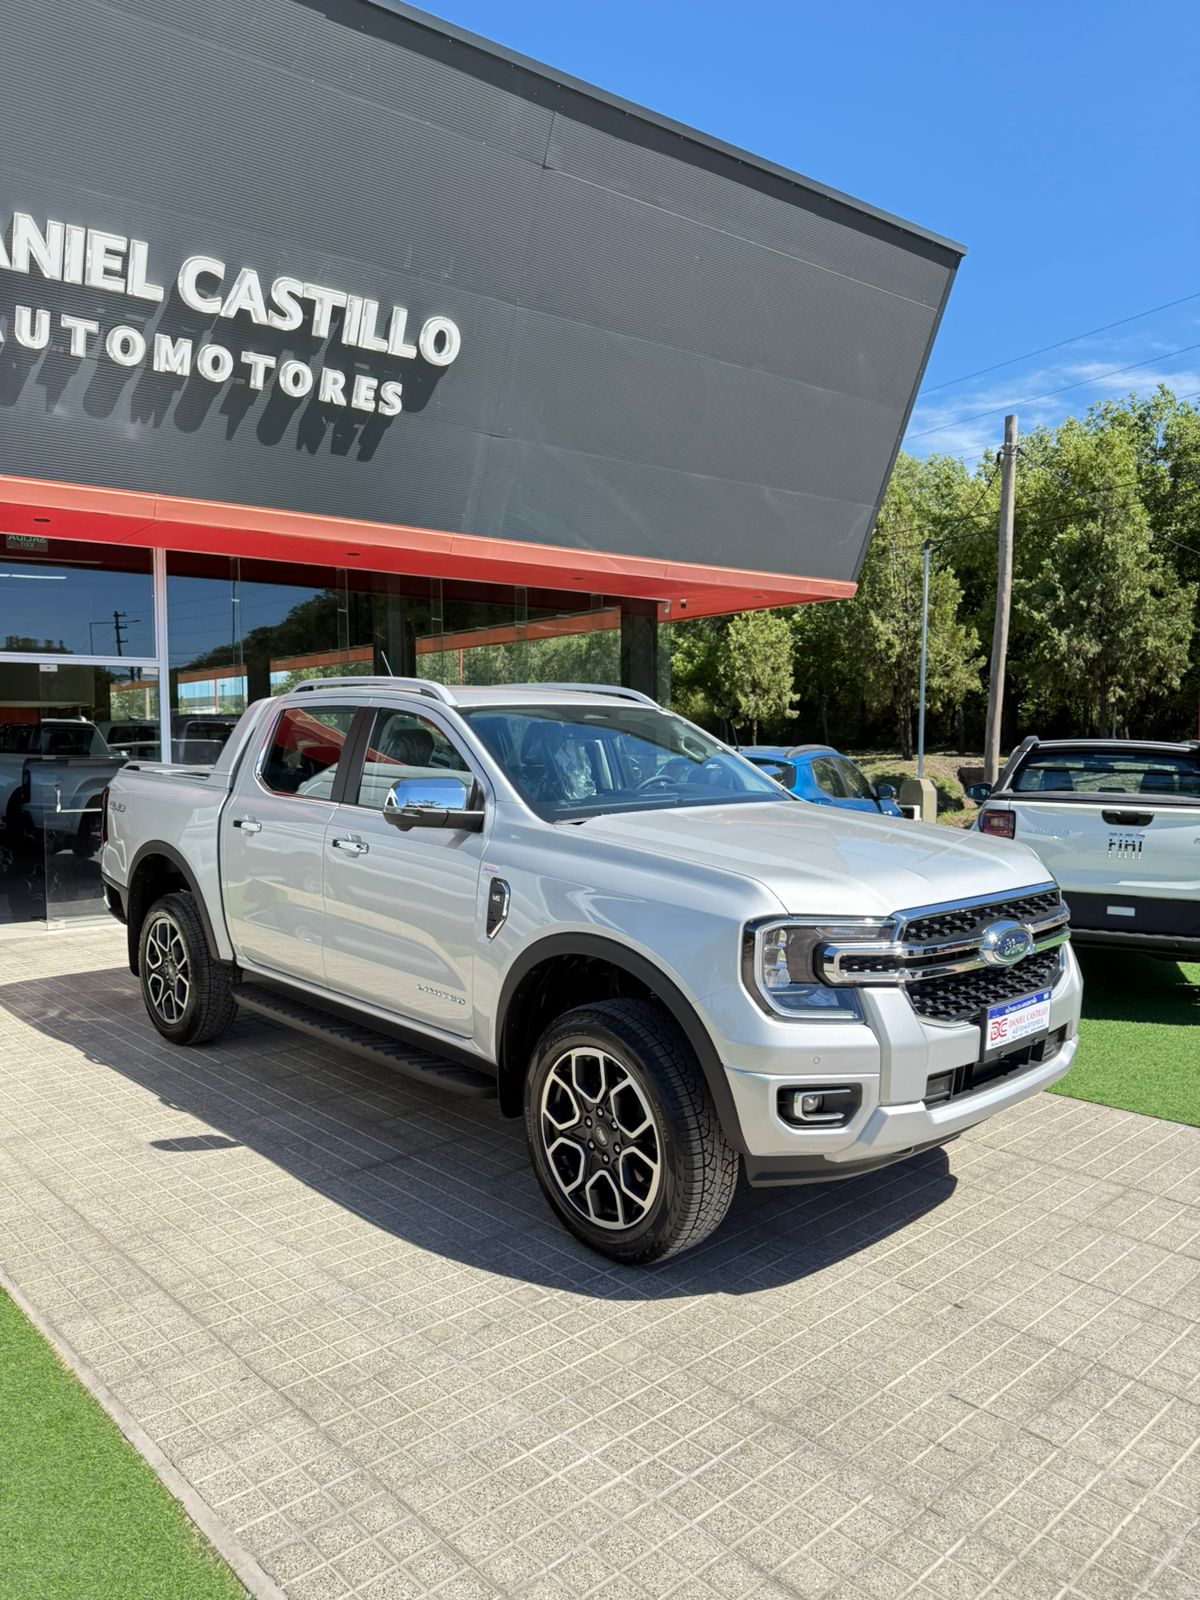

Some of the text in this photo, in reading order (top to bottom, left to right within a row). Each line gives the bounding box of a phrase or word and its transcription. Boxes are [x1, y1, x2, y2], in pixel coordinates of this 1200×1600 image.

[0, 212, 461, 366] NIEL CASTILLO
[0, 305, 403, 417] UTOMOTORES
[1003, 938, 1026, 957] Ford
[1009, 1014, 1026, 1028] DANIEL
